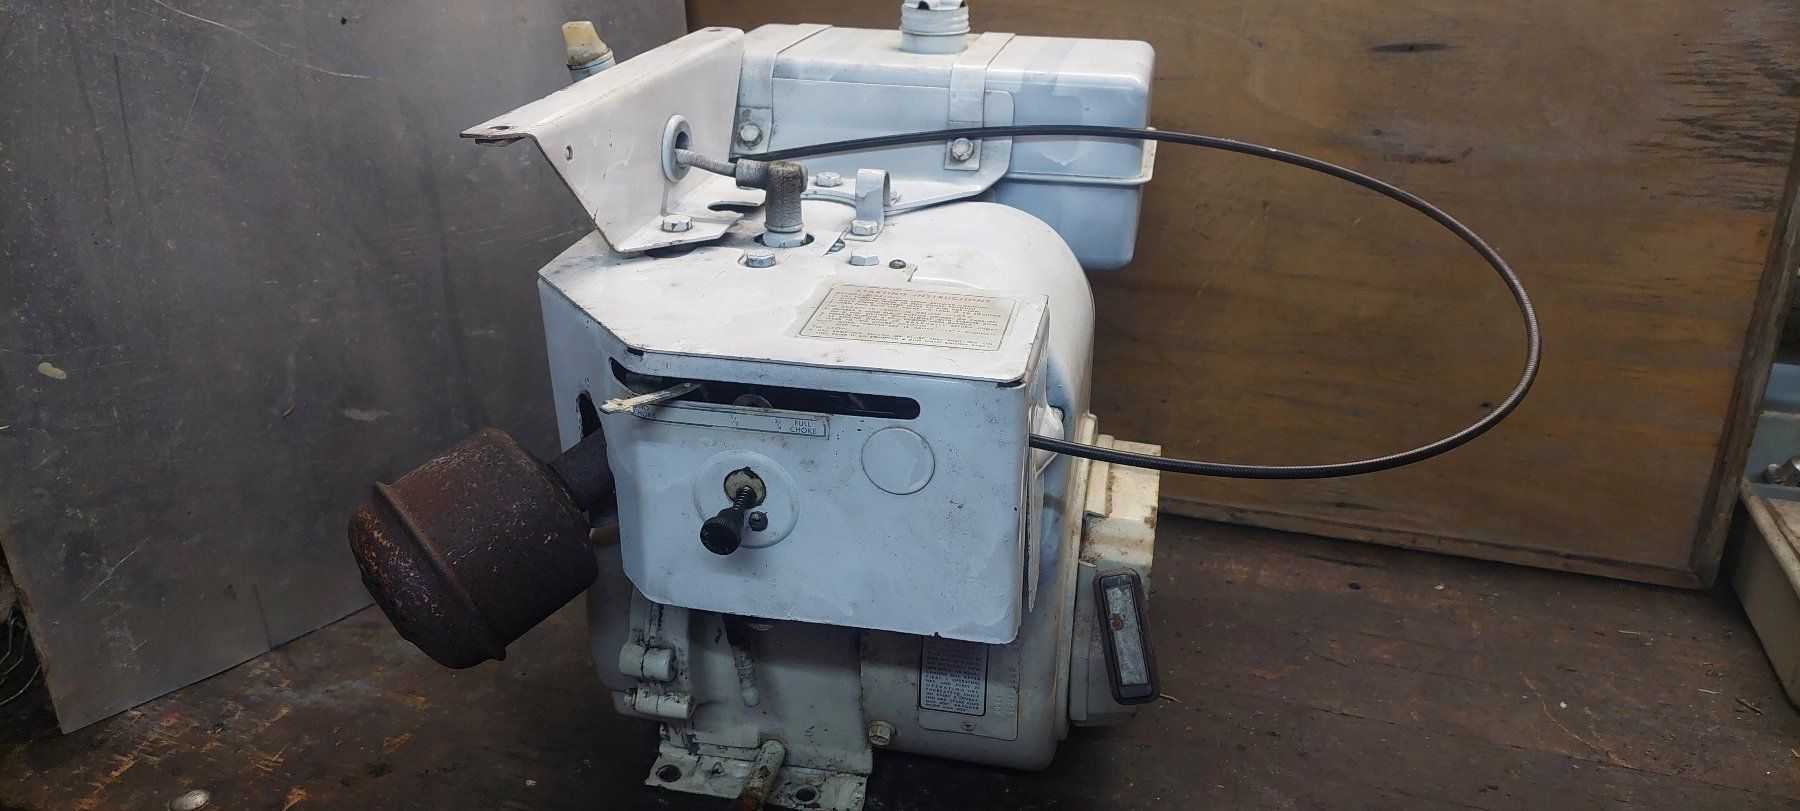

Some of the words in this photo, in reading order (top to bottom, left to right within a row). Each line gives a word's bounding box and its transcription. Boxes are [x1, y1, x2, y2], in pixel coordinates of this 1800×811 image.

[913, 293, 991, 303] INSTRUCTIONS
[794, 420, 811, 428] FULL
[789, 426, 817, 435] CHOKE
